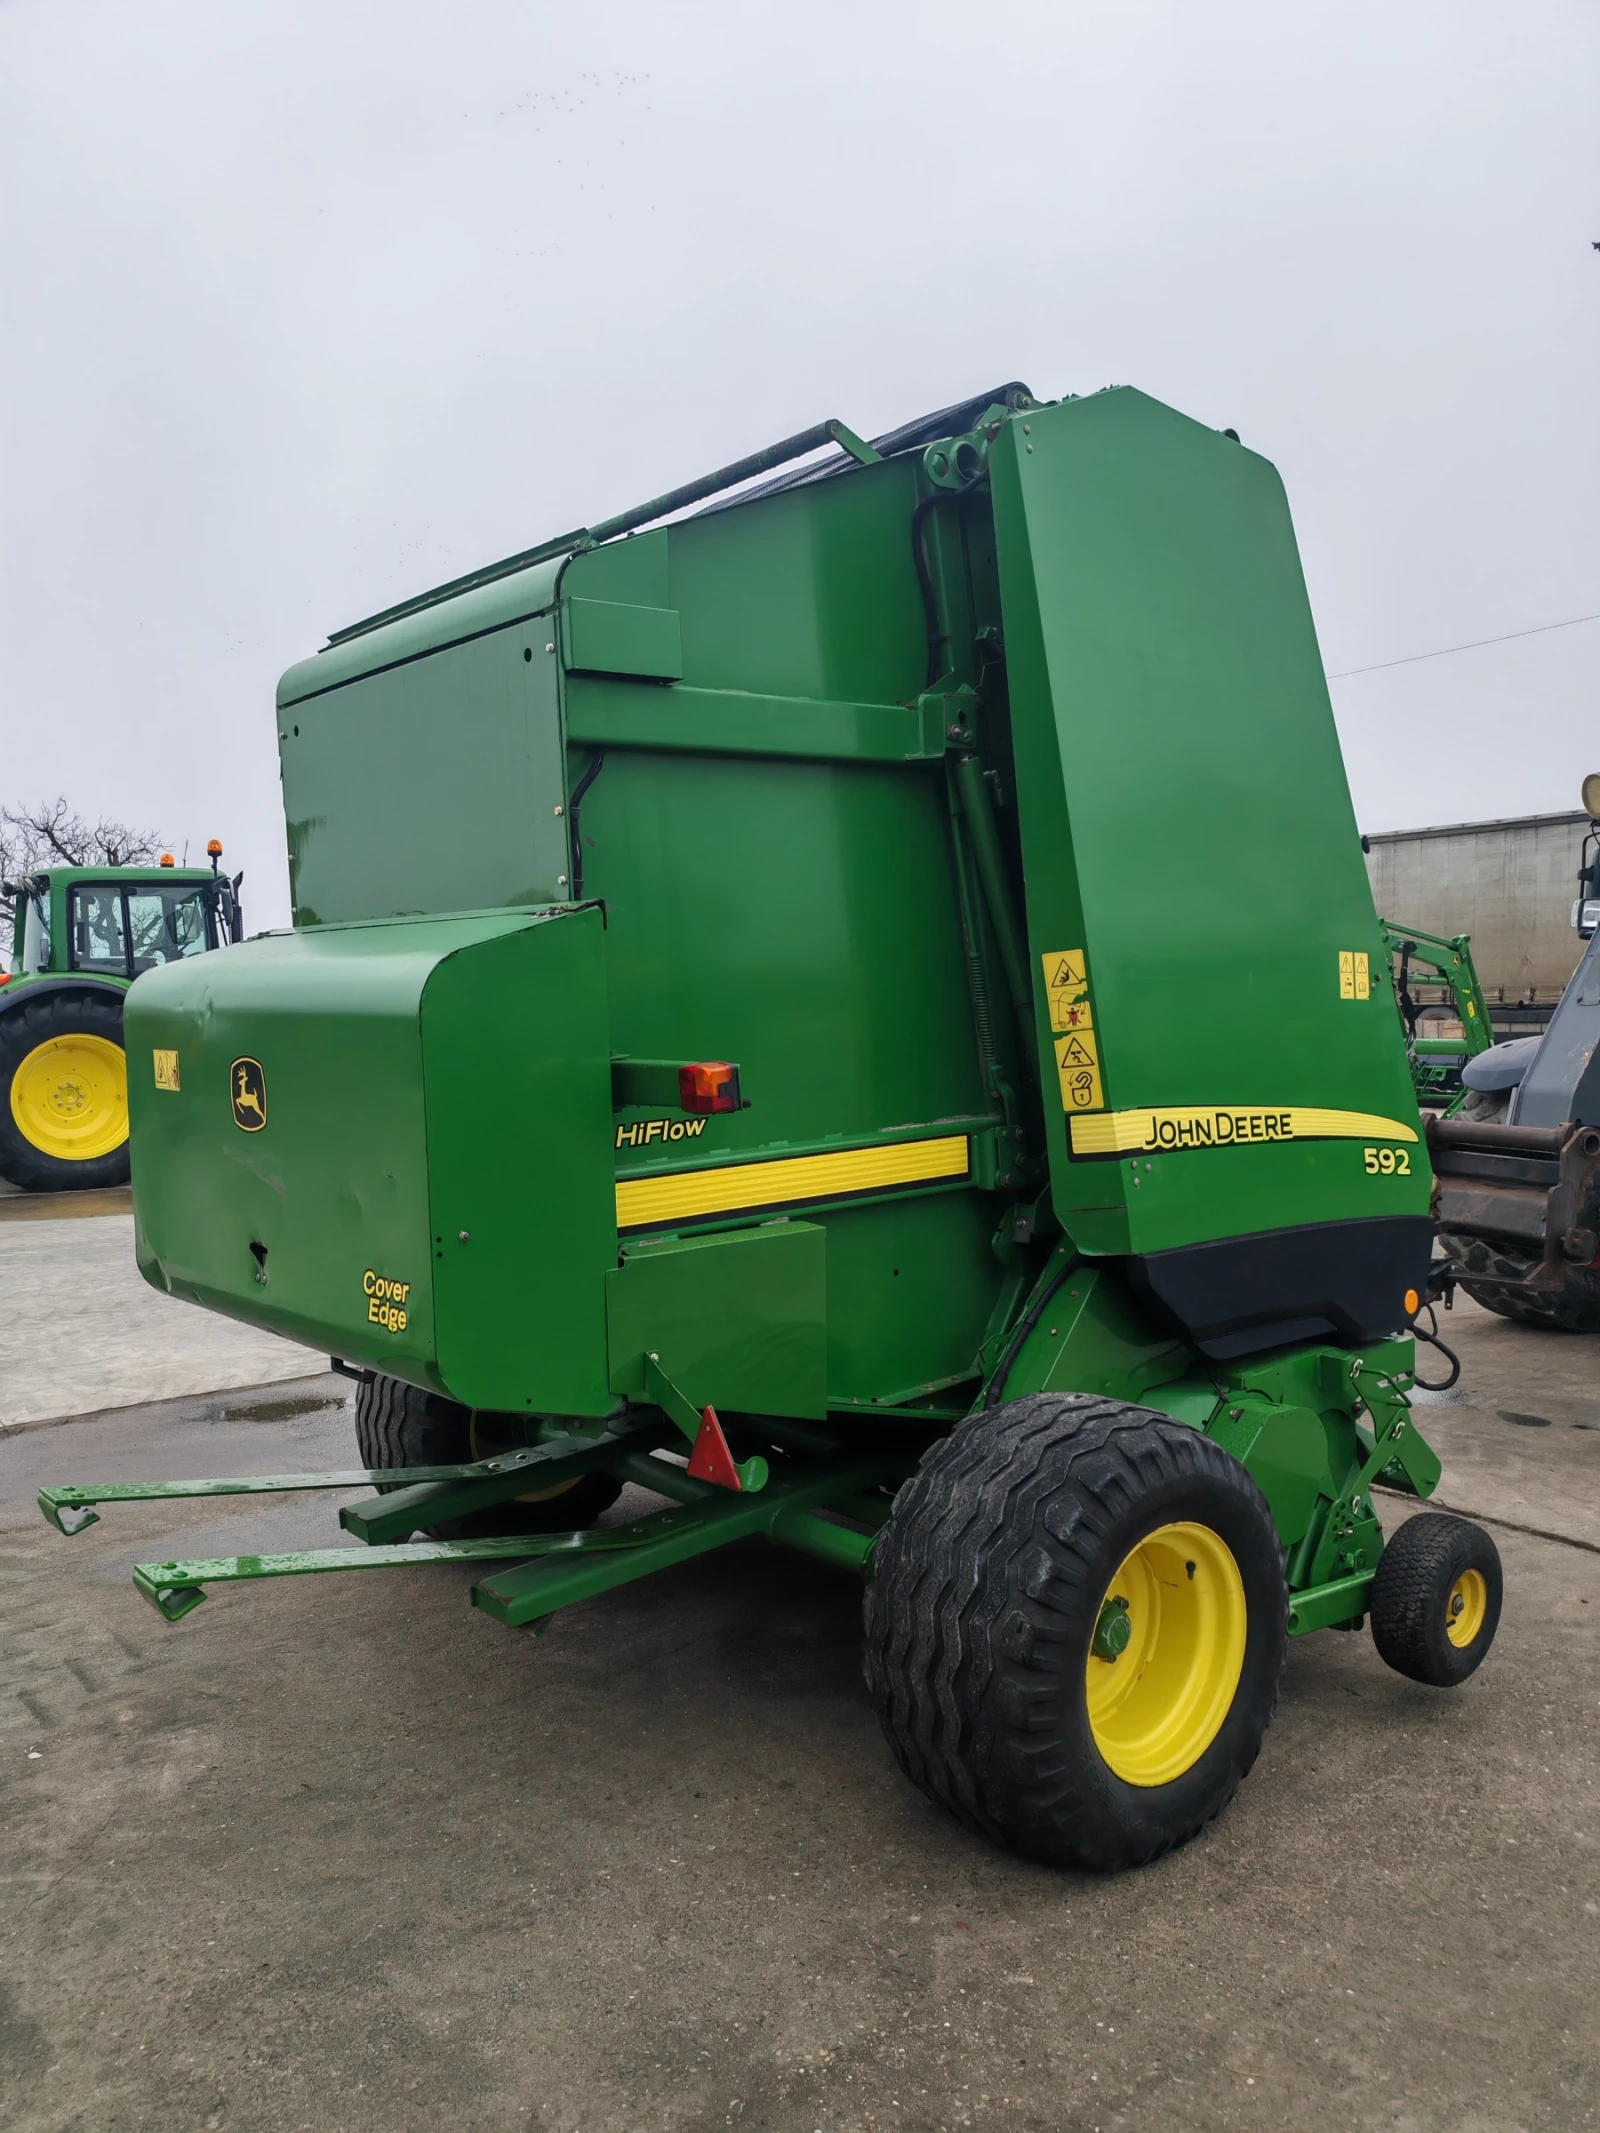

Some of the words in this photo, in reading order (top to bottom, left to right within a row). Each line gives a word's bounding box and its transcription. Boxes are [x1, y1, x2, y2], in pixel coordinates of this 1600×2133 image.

[615, 1118, 707, 1148] HiFlow
[1144, 1115, 1212, 1146] JOHN
[1215, 1112, 1293, 1141] DEERE
[1363, 1147, 1411, 1175] 592
[363, 1270, 410, 1303] Cover
[368, 1297, 407, 1332] Edge
